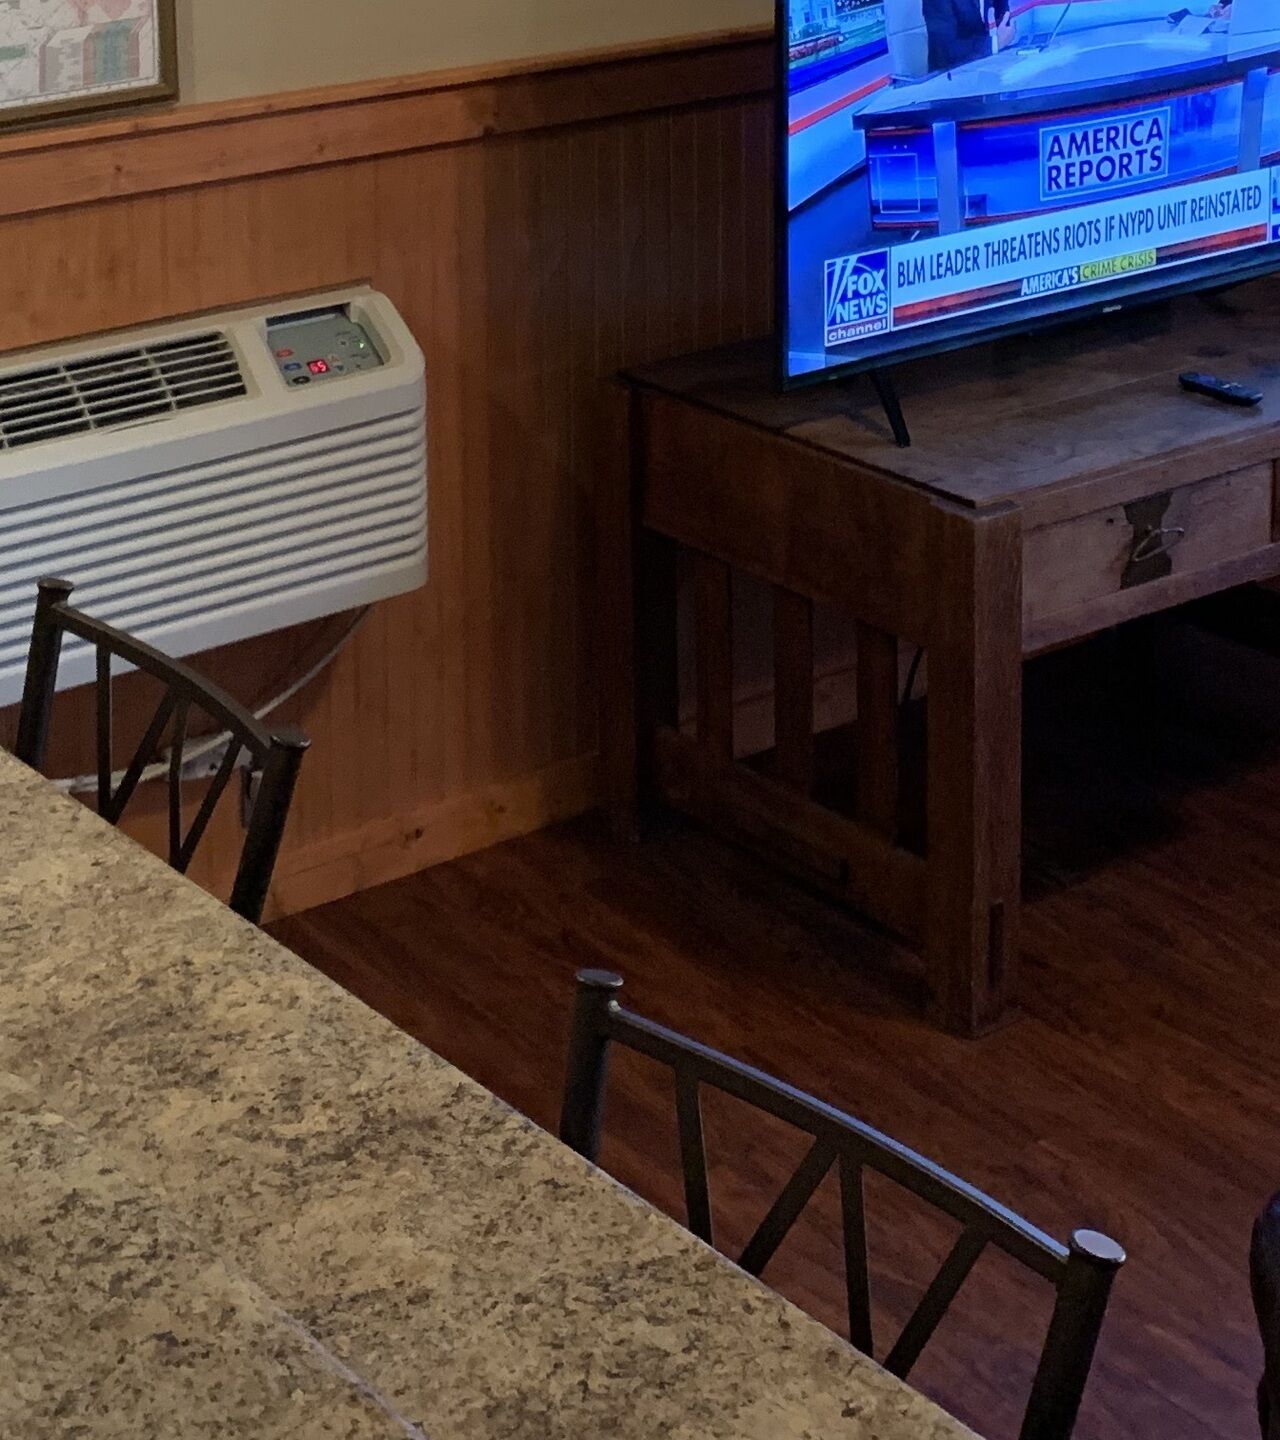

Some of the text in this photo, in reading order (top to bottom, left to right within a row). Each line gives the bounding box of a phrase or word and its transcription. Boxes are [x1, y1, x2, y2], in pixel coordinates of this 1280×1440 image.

[1046, 116, 1164, 162] AMERICA
[1046, 145, 1163, 192] REPORTS
[897, 185, 1263, 289] BLM LEADER THREATENS RIOTS IF NYPD UNIT REINSTATED
[846, 269, 885, 299] FOX
[1020, 250, 1155, 296] AMERICA'S CRIME CRISIS
[828, 318, 887, 342] channel
[835, 292, 887, 324] NEWS
